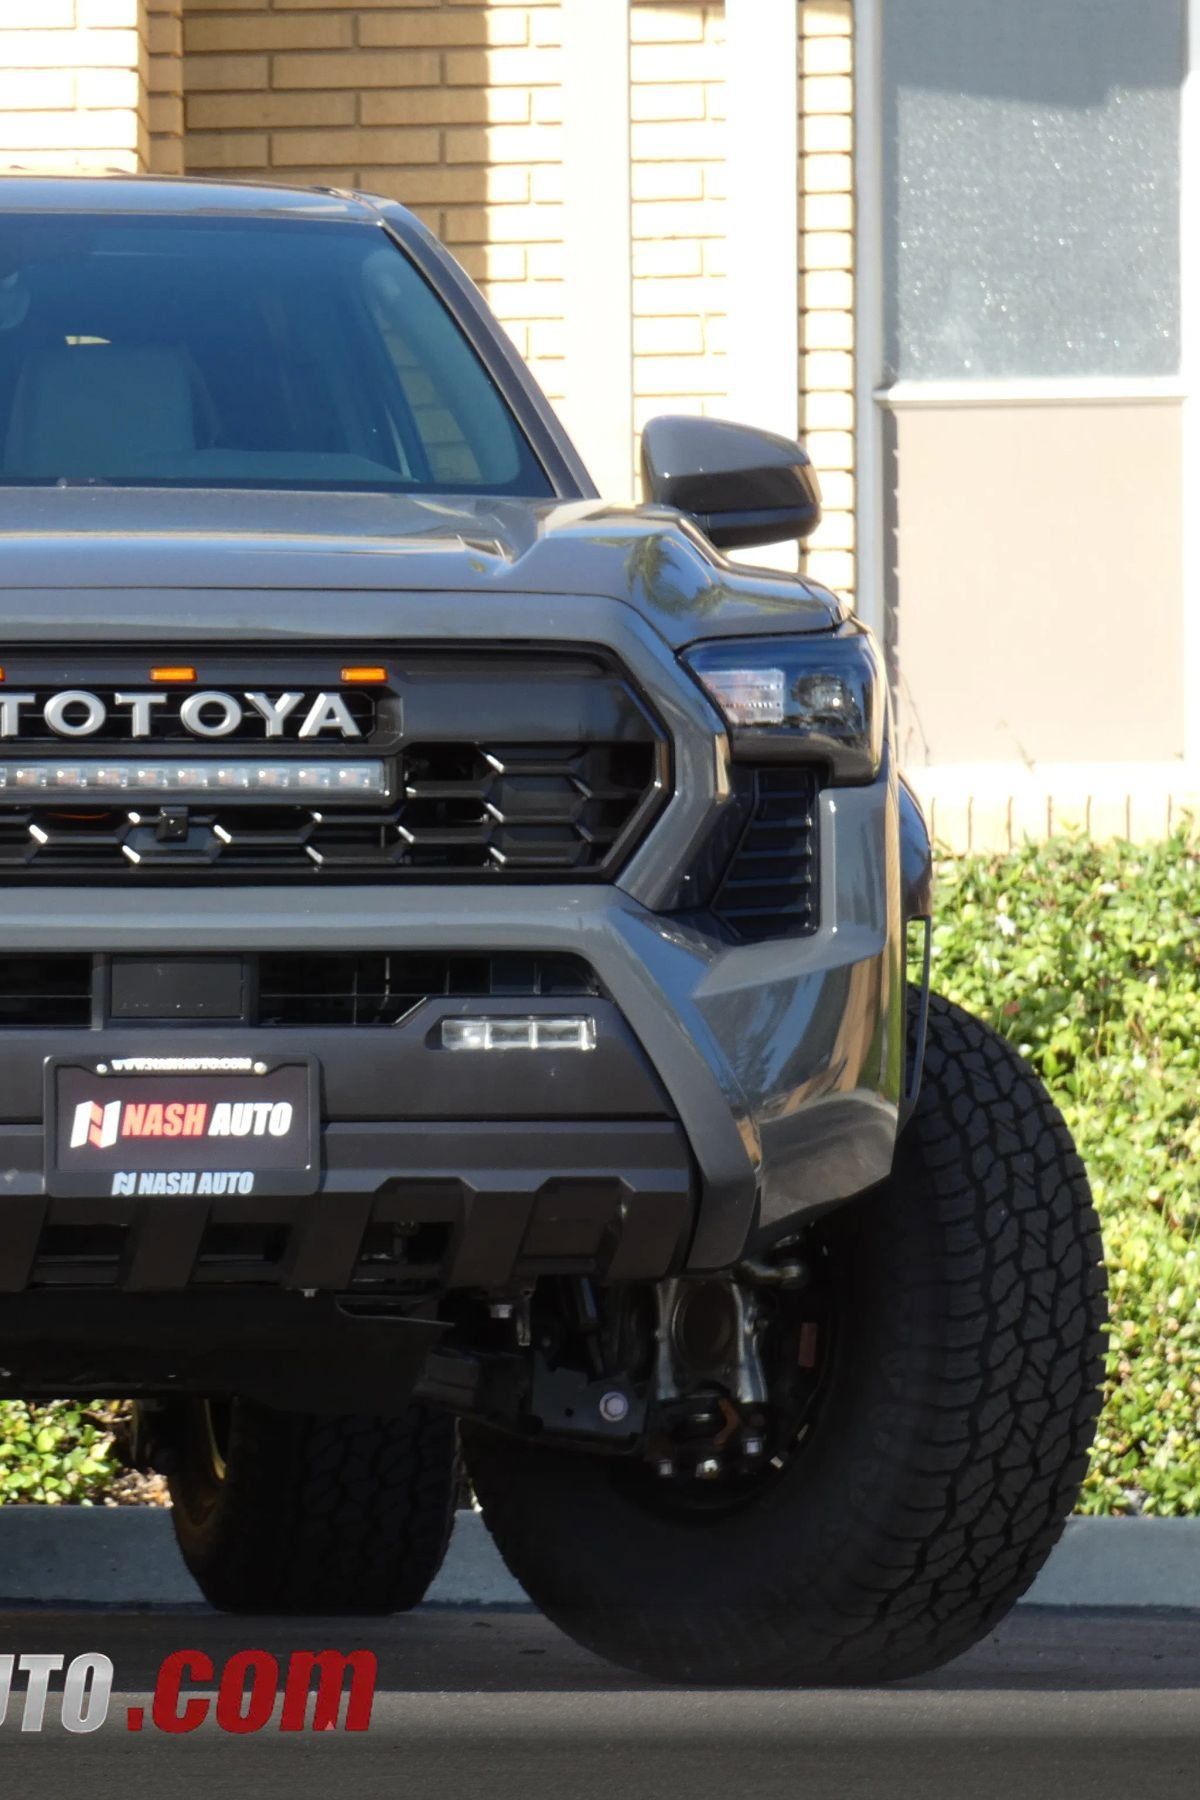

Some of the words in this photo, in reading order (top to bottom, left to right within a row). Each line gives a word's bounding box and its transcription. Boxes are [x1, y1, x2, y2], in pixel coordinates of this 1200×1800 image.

[121, 1103, 207, 1137] NASH
[207, 1102, 293, 1137] AUTO
[138, 1172, 196, 1195] NASH
[196, 1171, 255, 1195] AUTO
